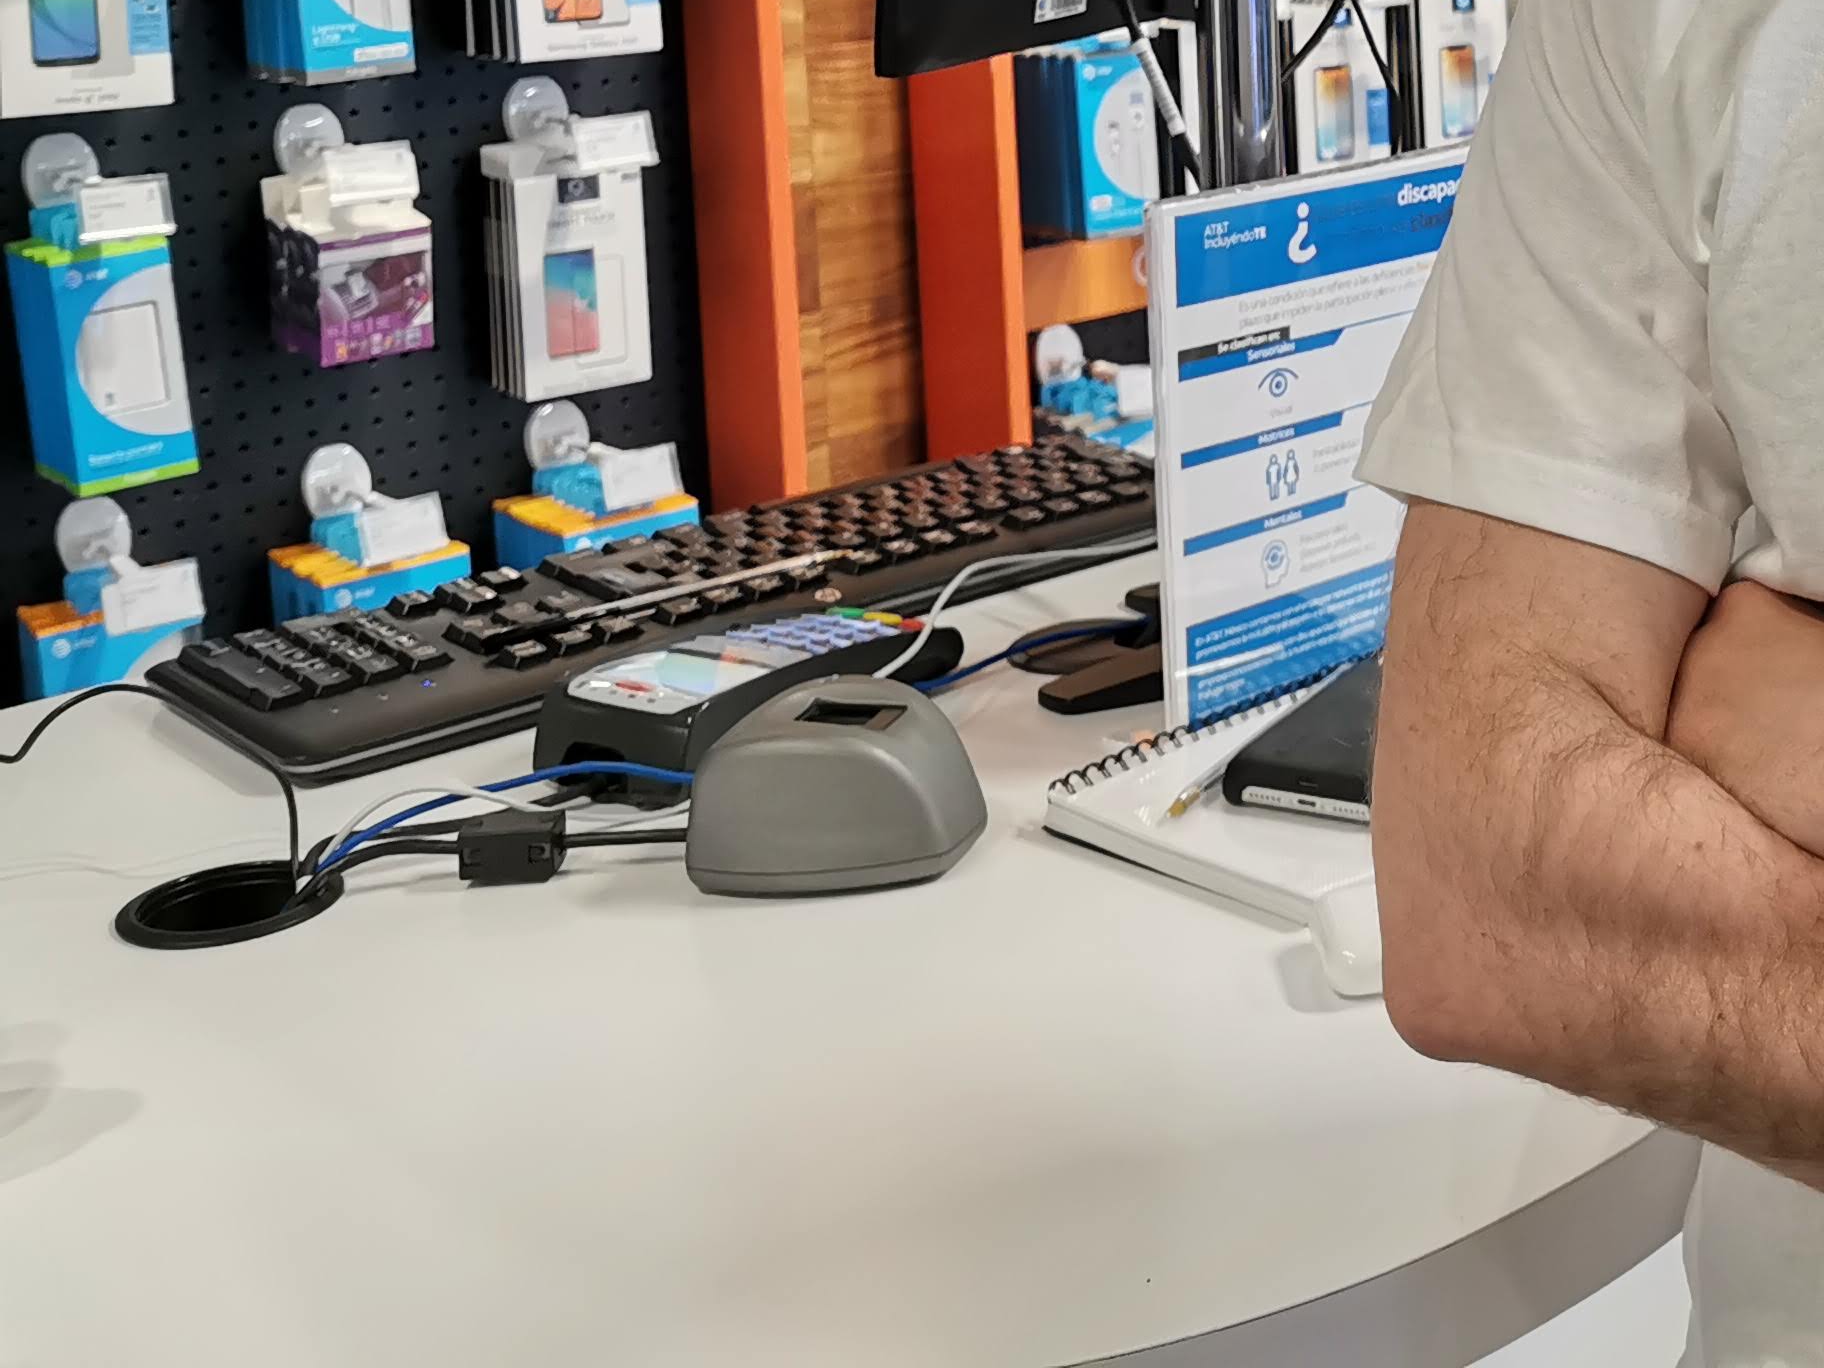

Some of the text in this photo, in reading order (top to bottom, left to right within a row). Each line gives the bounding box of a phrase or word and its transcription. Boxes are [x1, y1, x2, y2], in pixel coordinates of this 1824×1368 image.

[1204, 220, 1230, 238] AT&T
[1204, 225, 1268, 250] IncluyéndoTE
[1264, 509, 1303, 529] Mentales
